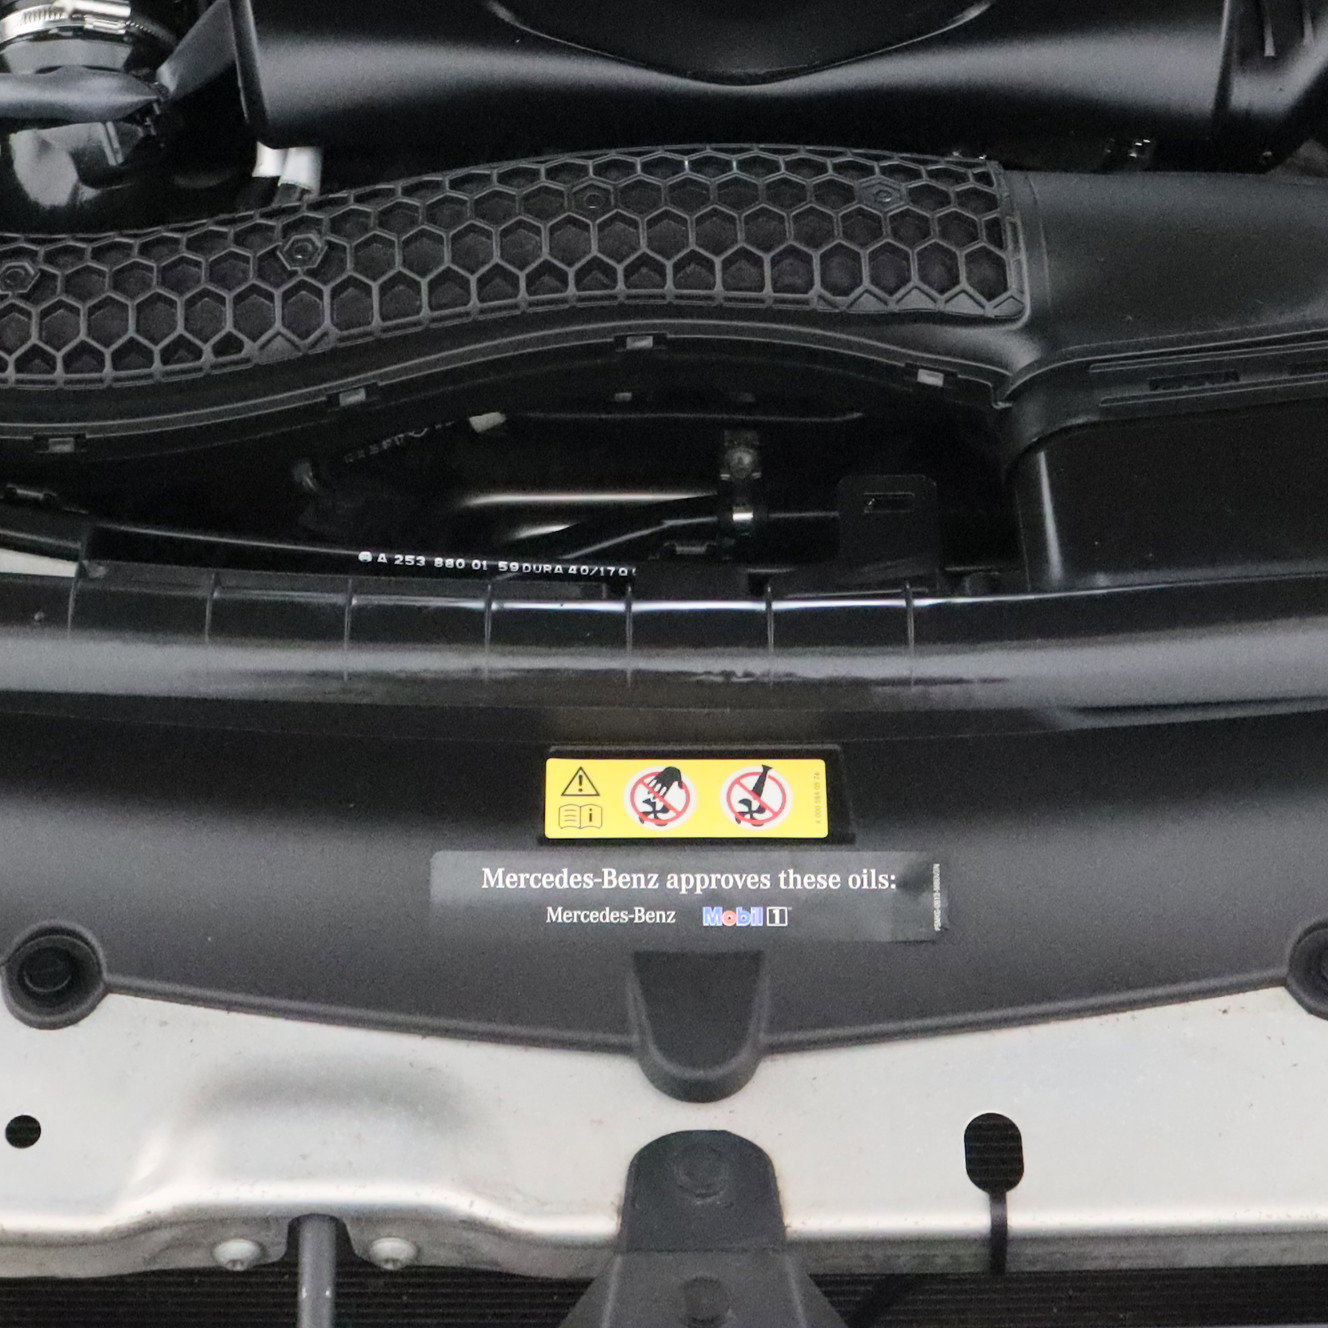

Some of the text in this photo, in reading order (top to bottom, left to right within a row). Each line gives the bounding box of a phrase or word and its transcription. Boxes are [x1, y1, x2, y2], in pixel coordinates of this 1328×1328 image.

[393, 554, 426, 567] 253
[434, 557, 465, 569] 880
[471, 559, 488, 571] 01
[521, 563, 564, 574] DURA
[481, 867, 897, 895] Mercedes-Benz approves these oils:
[545, 906, 677, 924] Mercedes-Benz
[702, 906, 764, 927] Mobil
